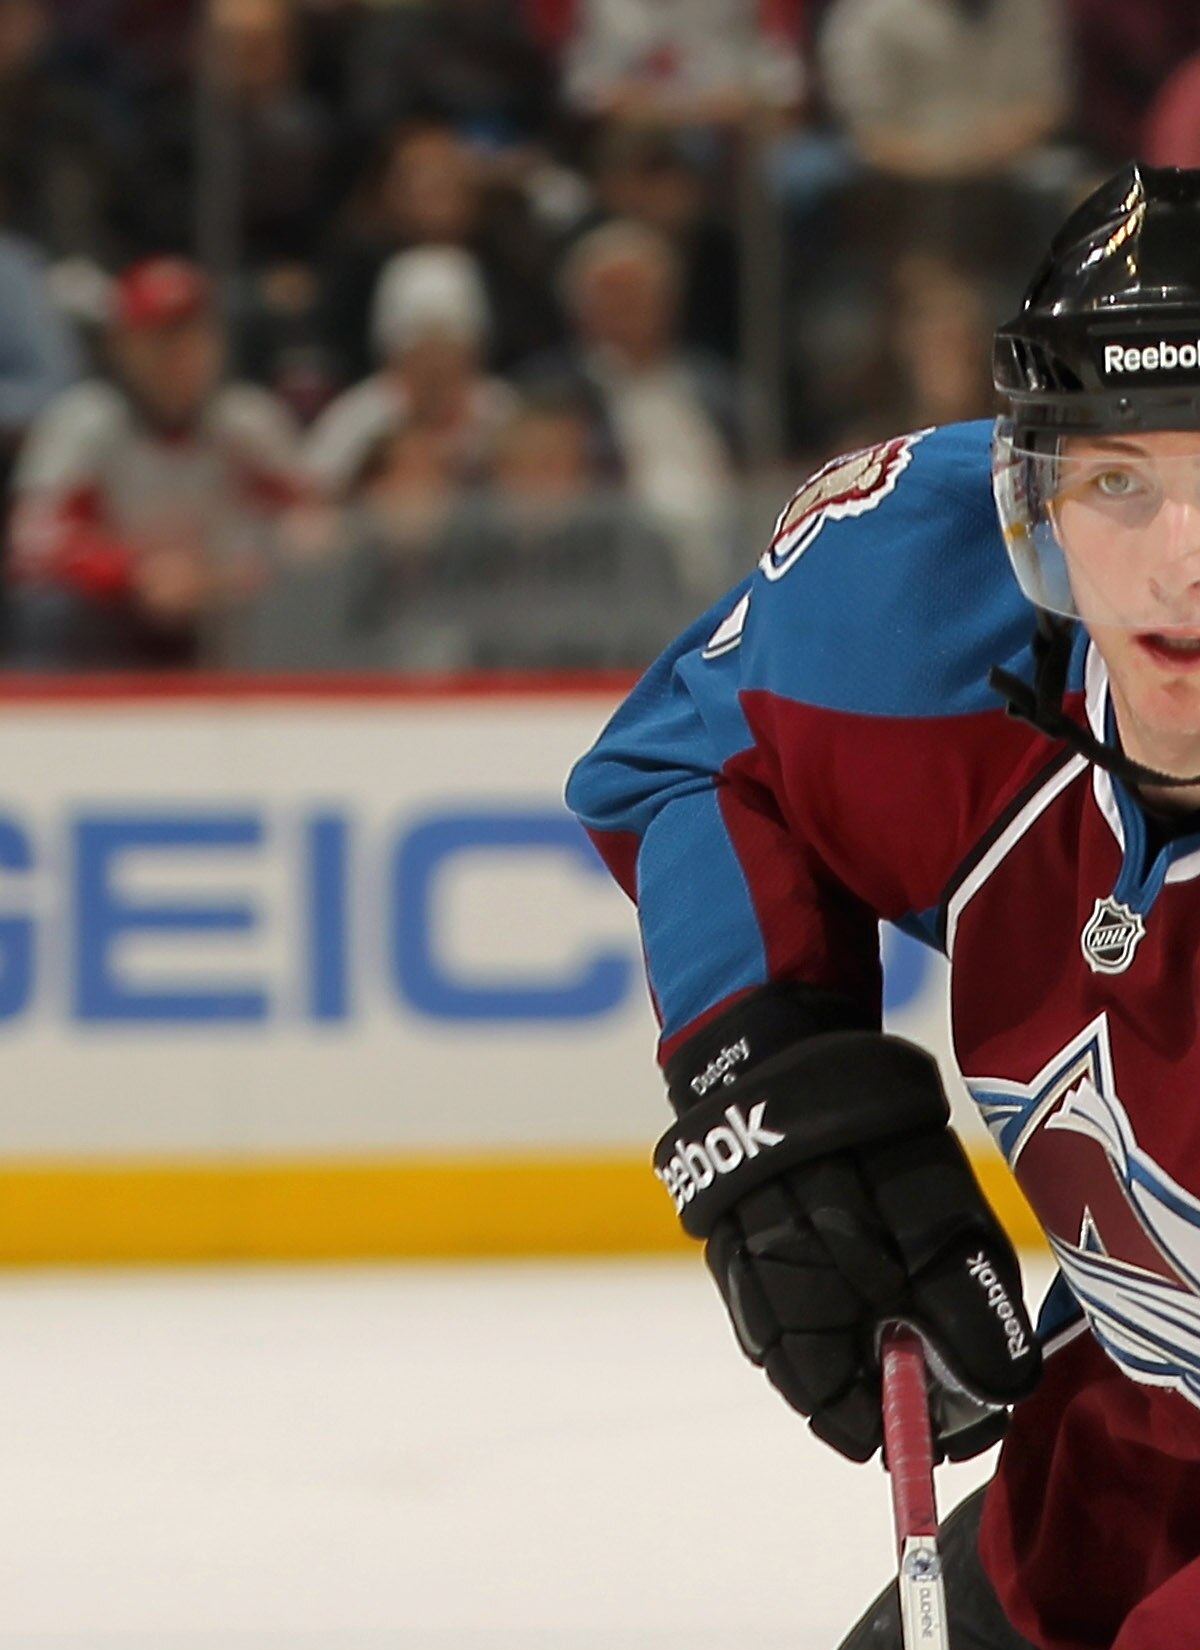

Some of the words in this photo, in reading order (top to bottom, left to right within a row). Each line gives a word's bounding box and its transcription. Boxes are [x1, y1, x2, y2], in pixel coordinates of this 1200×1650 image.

[1091, 927, 1128, 948] NHL
[654, 1101, 787, 1217] eebok
[966, 1250, 1030, 1360] Reebok
